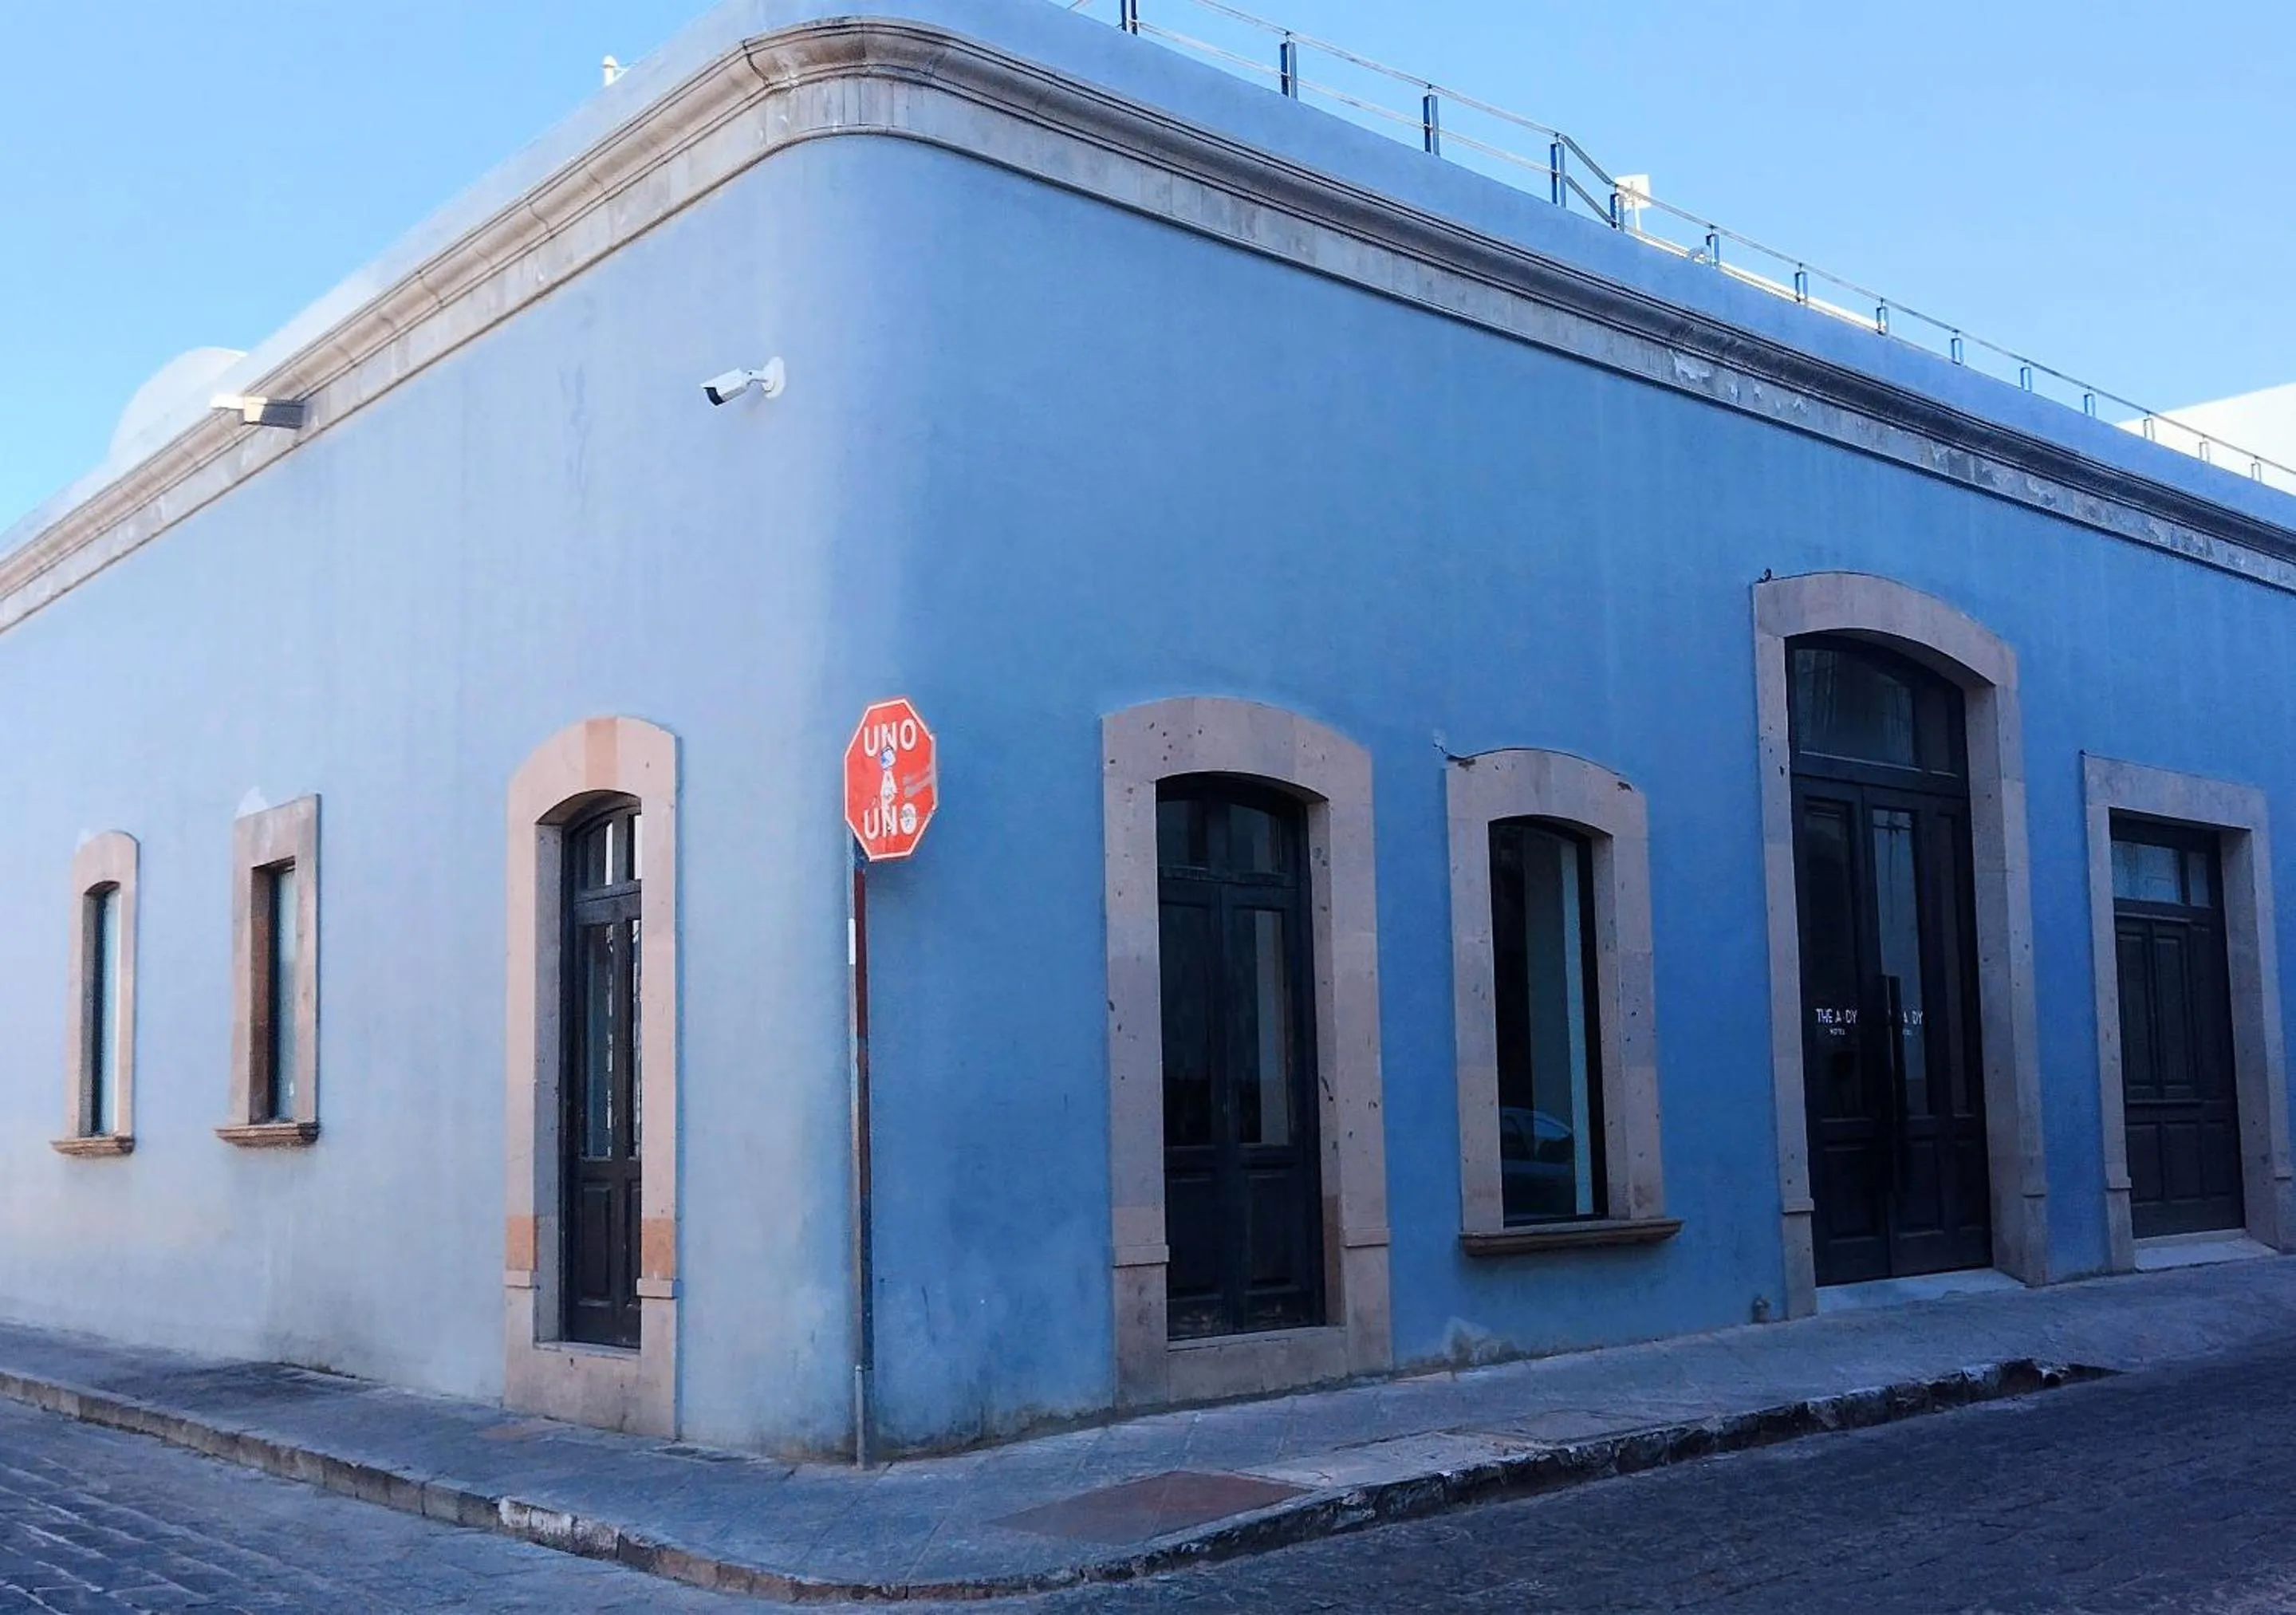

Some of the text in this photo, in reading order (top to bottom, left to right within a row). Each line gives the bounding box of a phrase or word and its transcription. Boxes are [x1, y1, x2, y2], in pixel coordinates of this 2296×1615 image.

[864, 719, 916, 757] UNO
[864, 802, 916, 839] UNO
[1816, 1008, 1833, 1023] THE
